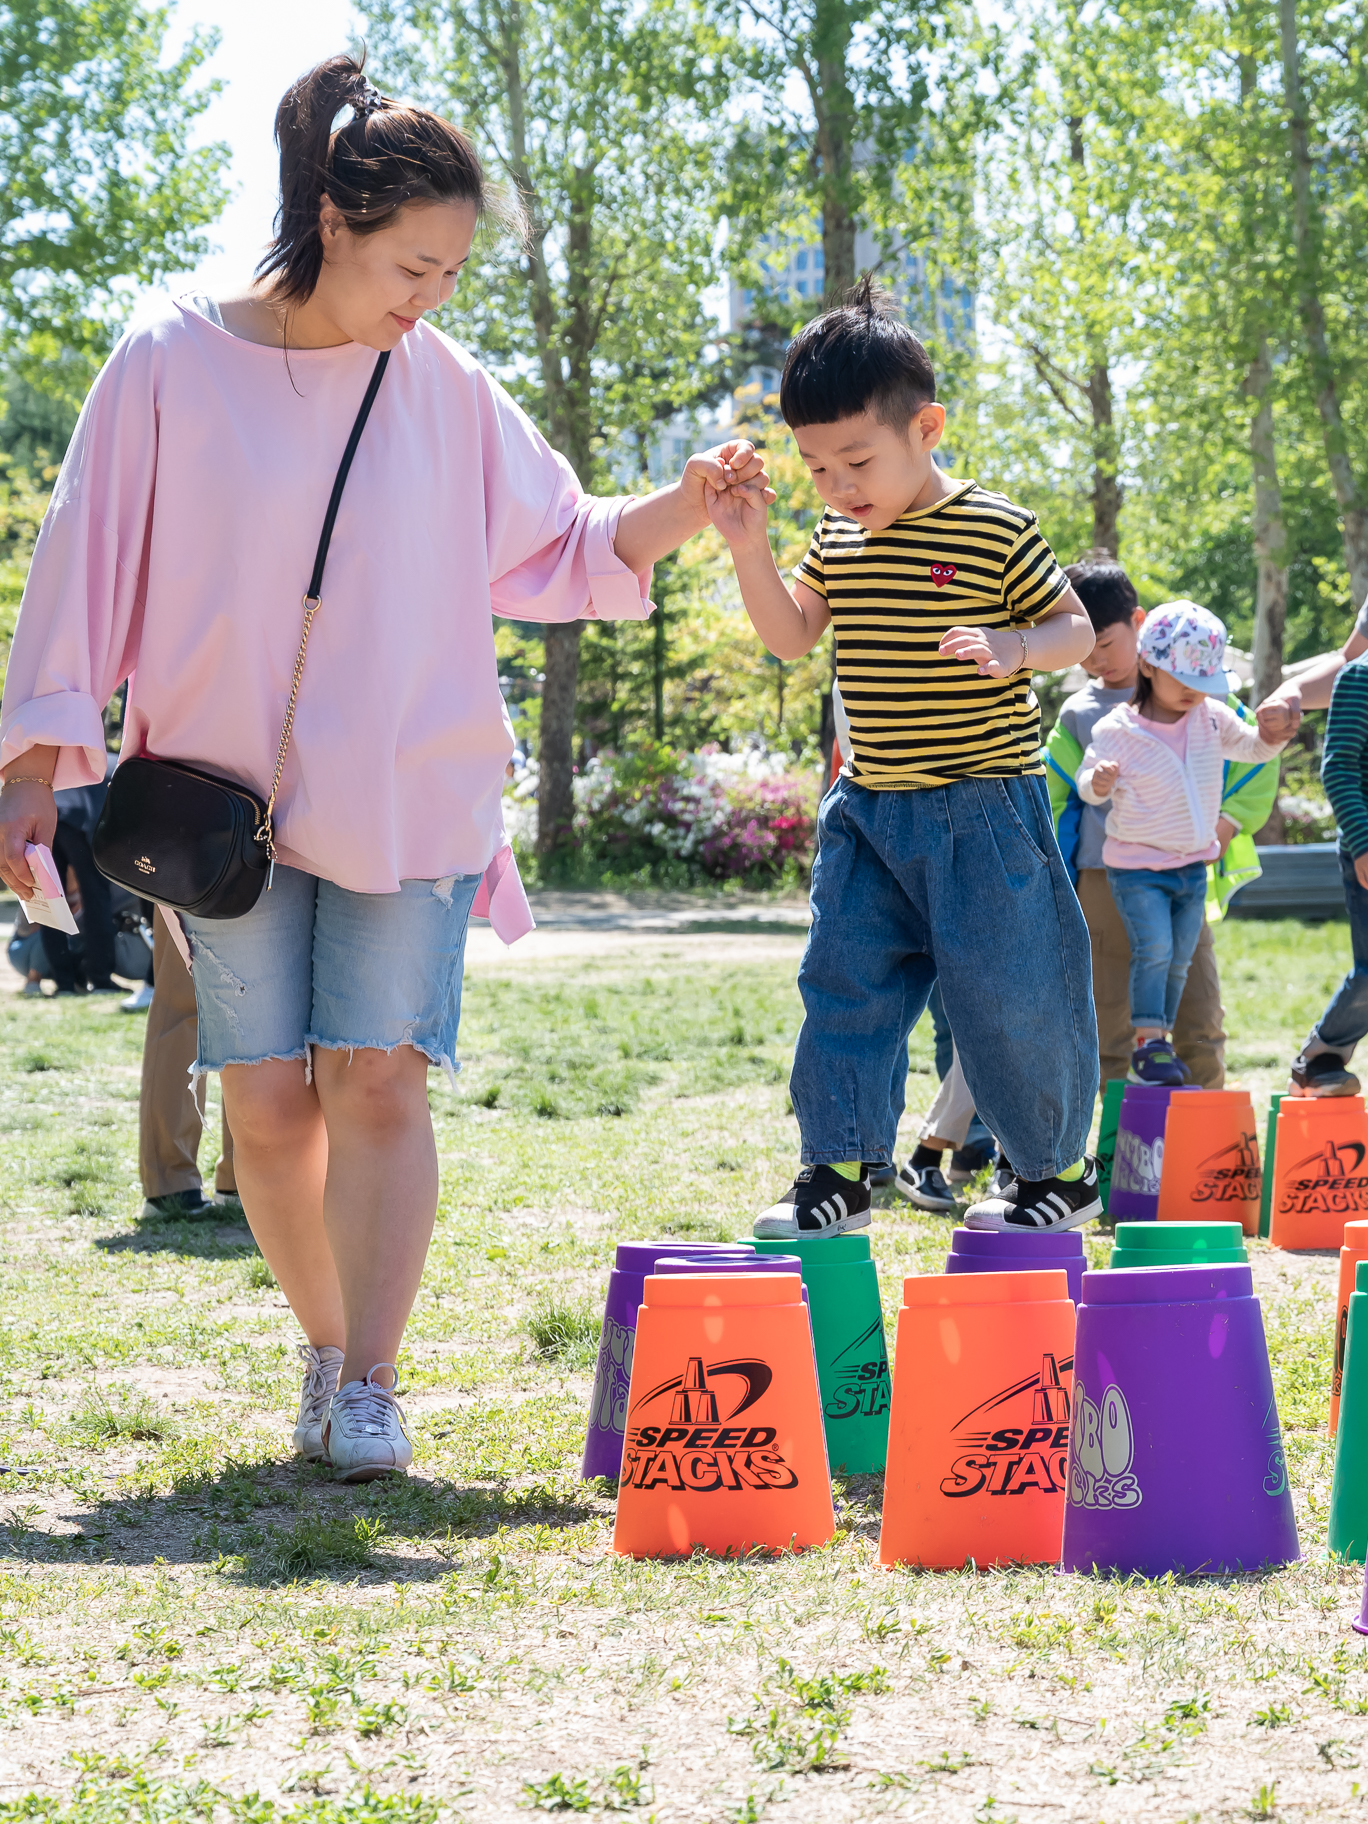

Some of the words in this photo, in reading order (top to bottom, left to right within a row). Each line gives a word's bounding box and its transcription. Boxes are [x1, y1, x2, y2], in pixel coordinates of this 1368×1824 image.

[1295, 1177, 1360, 1191] SPEED
[636, 1427, 777, 1448] SPEED
[621, 1448, 799, 1492] STACKS
